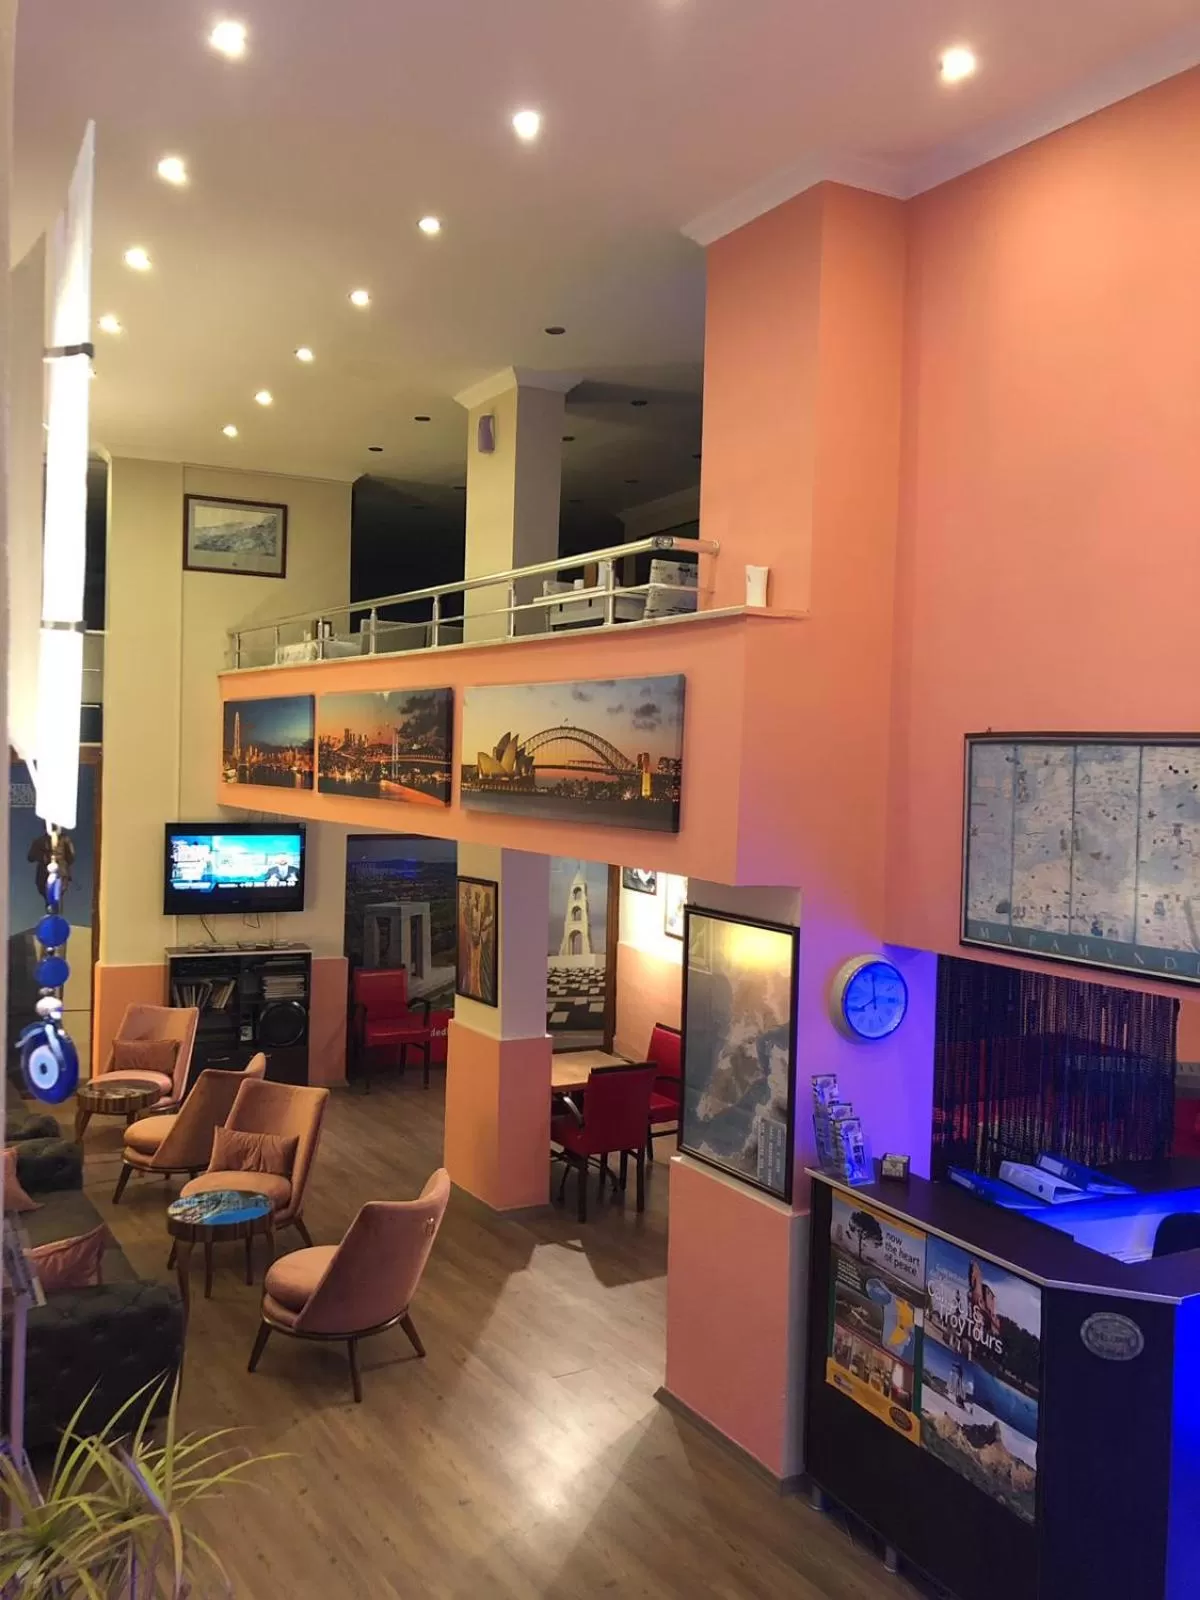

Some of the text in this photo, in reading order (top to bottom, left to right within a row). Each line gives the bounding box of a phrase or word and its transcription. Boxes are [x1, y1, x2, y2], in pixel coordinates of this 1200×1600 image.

[886, 1232, 902, 1246] now
[884, 1252, 893, 1263] of
[894, 1258, 917, 1277] peace
[885, 1241, 920, 1267] the heart
